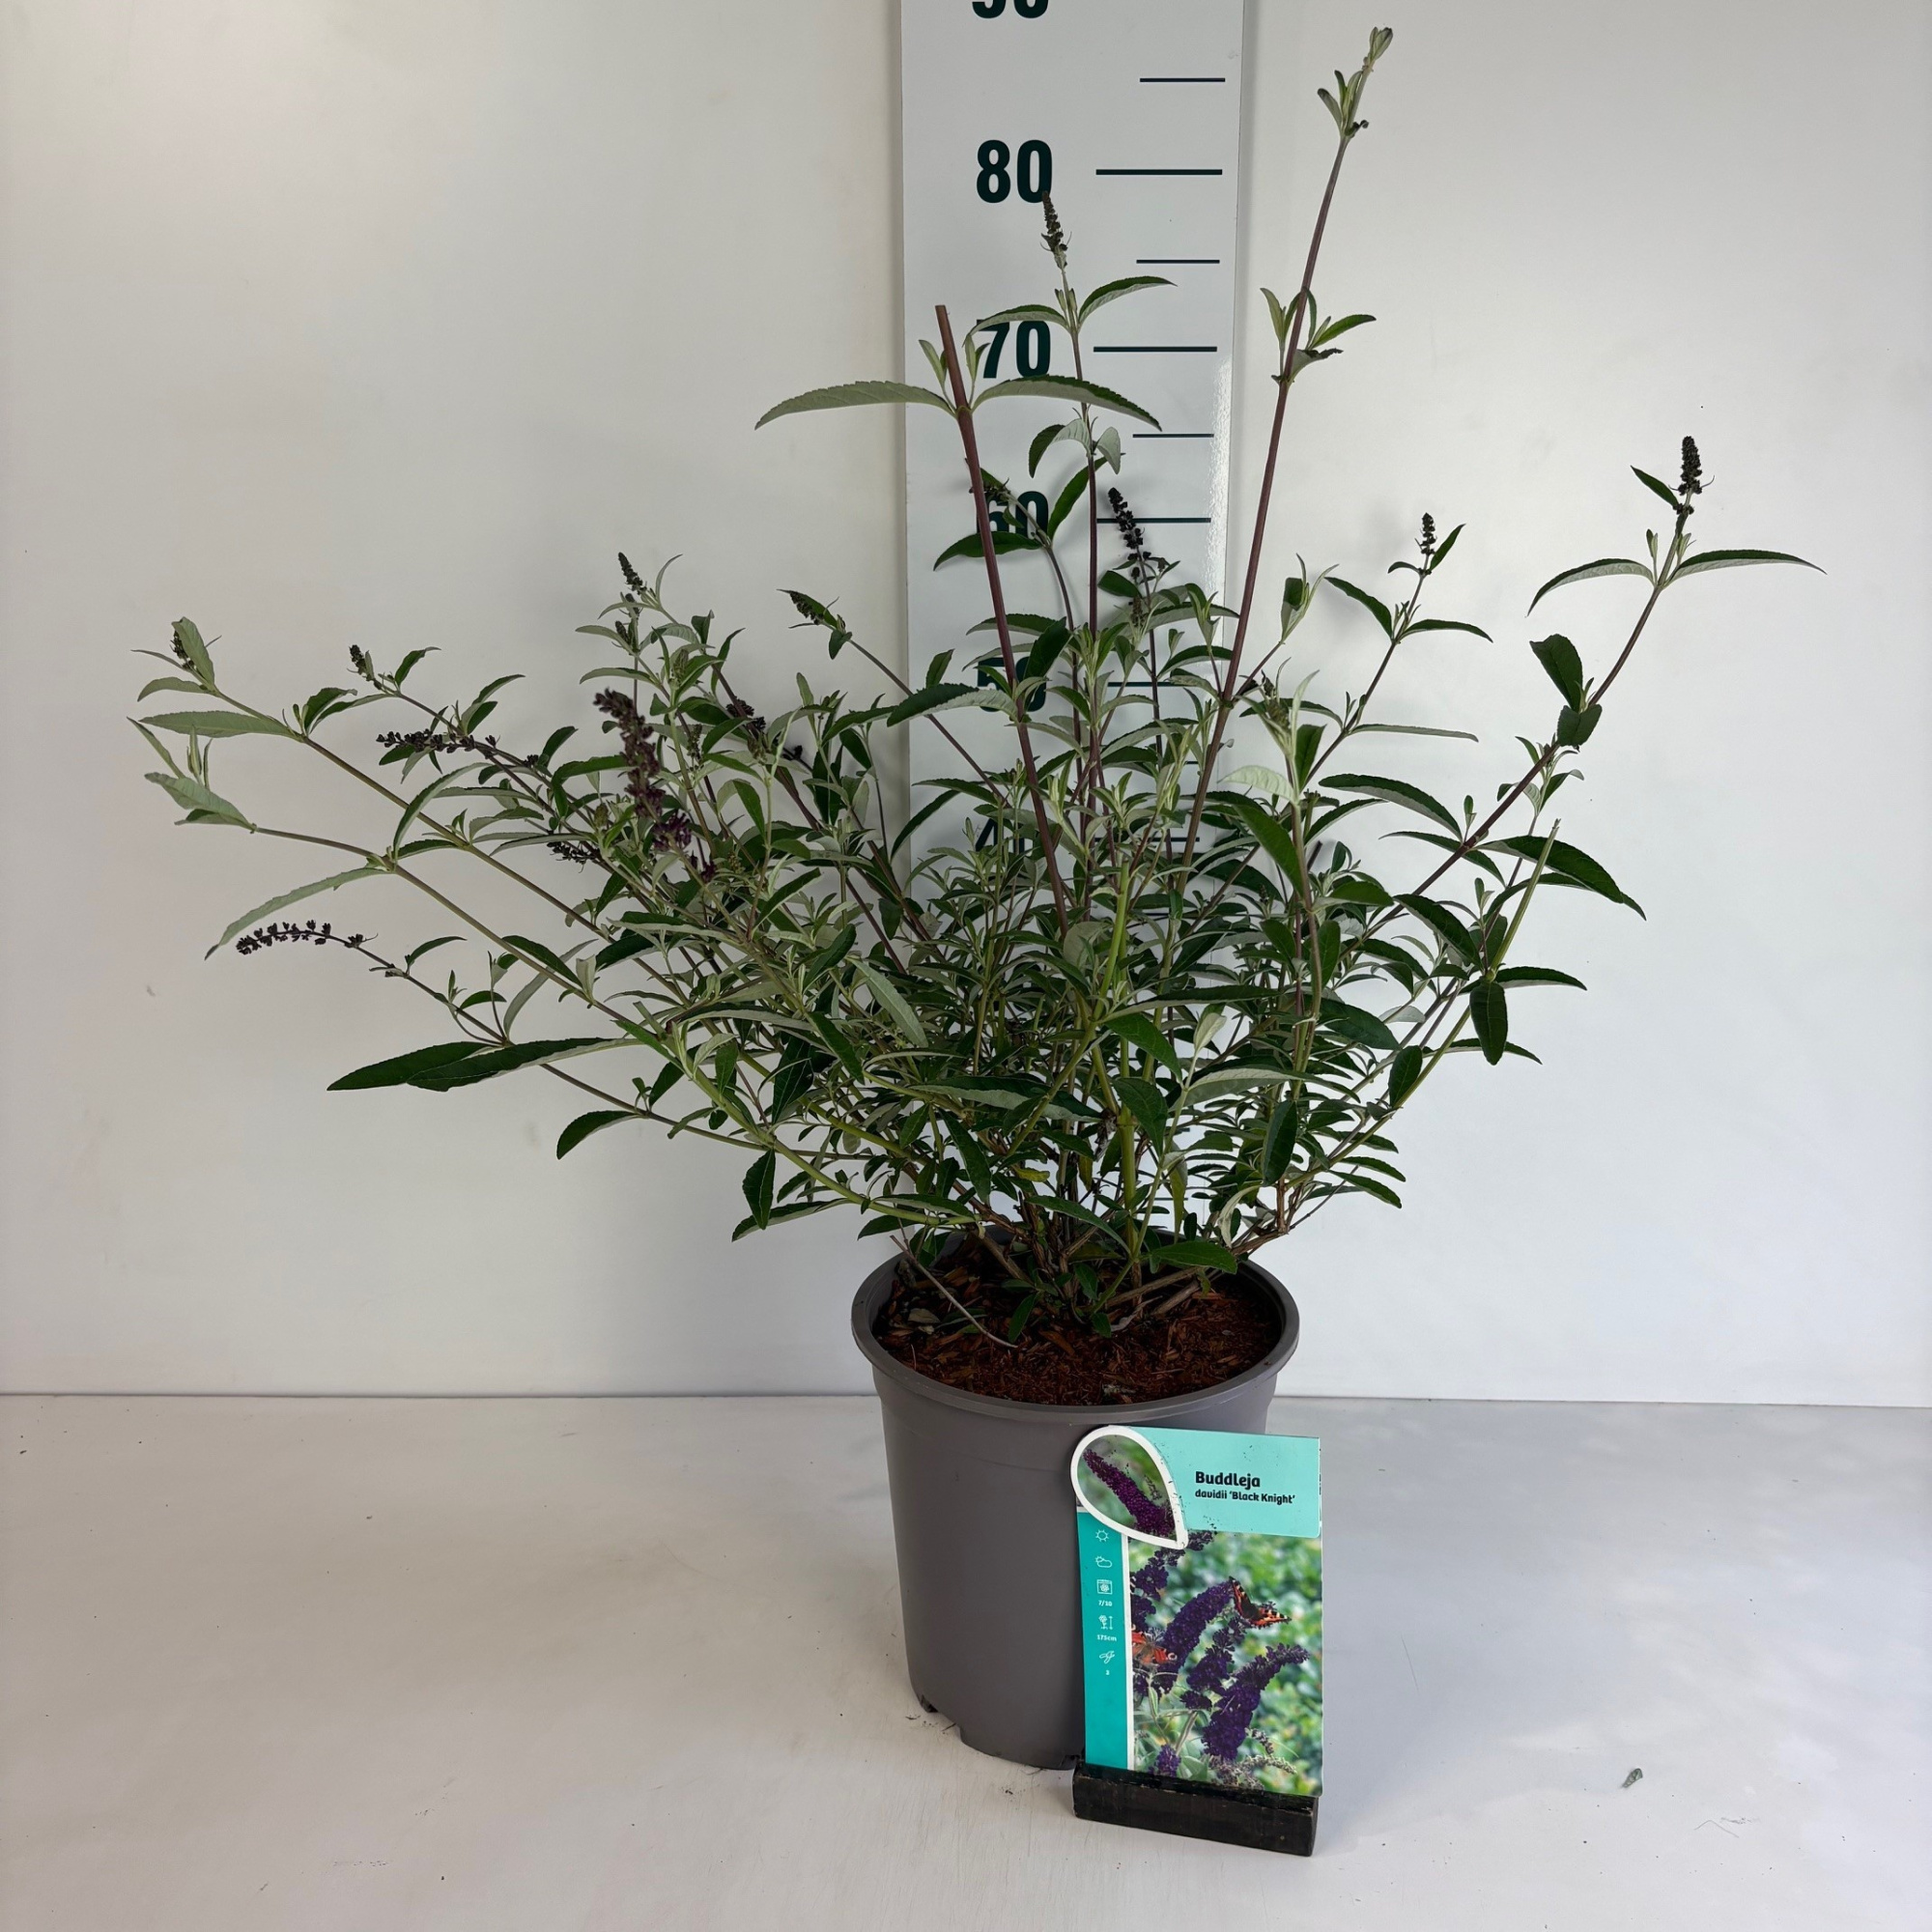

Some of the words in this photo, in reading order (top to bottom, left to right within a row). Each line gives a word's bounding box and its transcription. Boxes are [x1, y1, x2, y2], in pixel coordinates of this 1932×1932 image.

[977, 139, 1052, 204] 80
[976, 318, 1051, 379] 70
[1195, 1470, 1261, 1491] Buddleja
[1195, 1489, 1228, 1499] davidii
